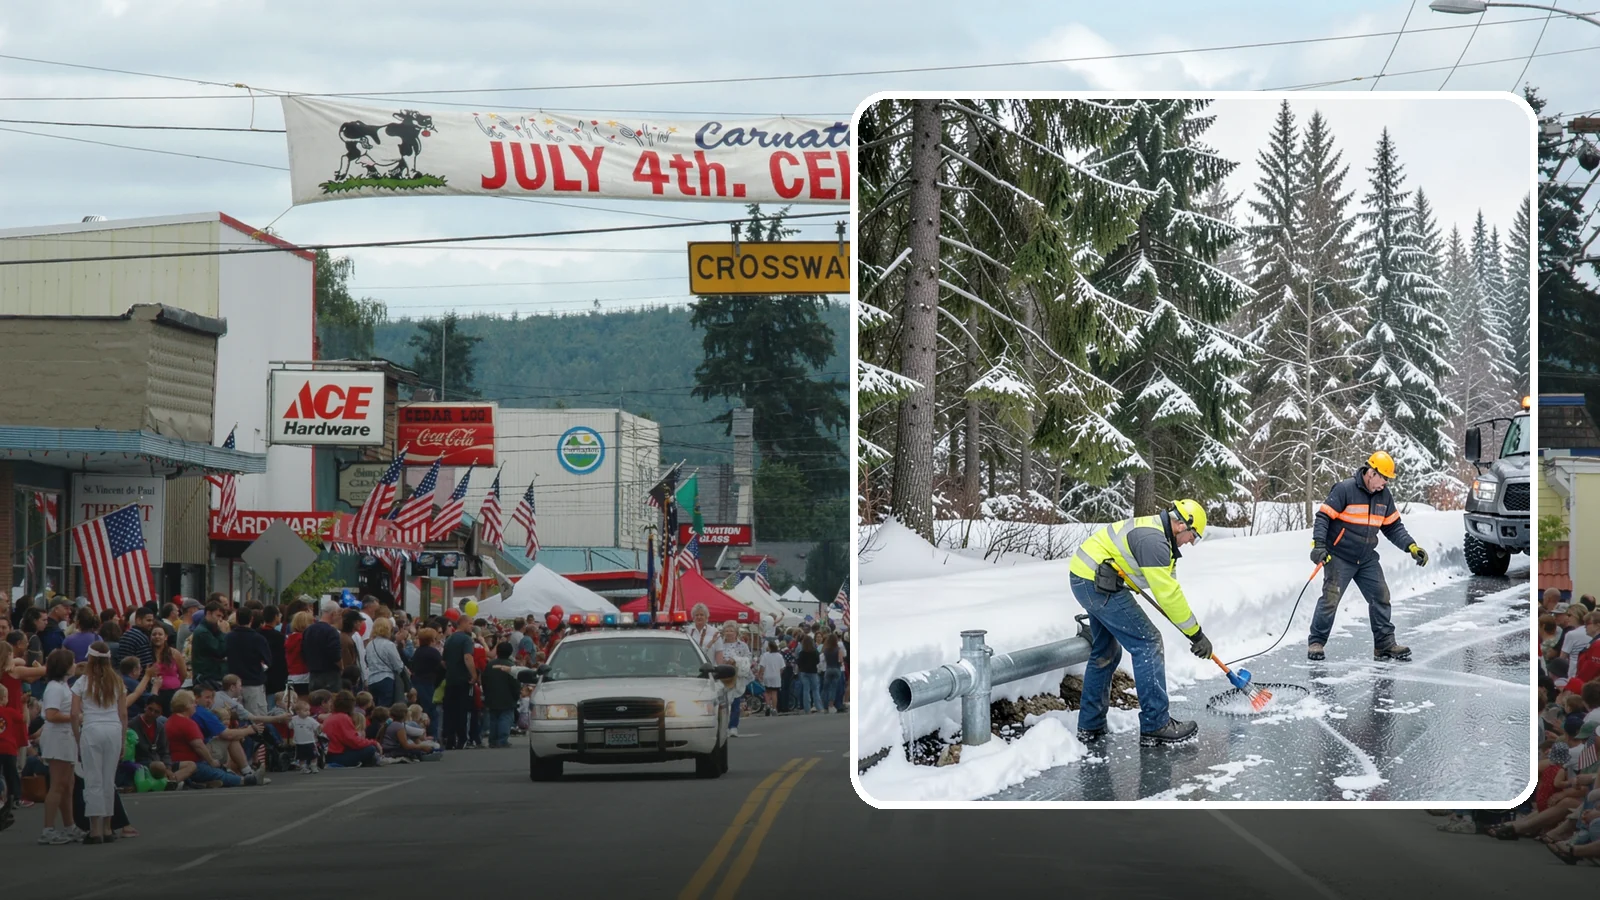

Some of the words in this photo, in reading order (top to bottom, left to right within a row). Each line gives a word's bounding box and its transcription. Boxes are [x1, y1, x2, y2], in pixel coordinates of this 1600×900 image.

[481, 141, 605, 192] JULY
[632, 150, 746, 197] 4th.
[697, 254, 850, 280] CROSSWA
[283, 380, 373, 420] ACE
[405, 409, 452, 422] CEDAR
[283, 421, 371, 436] Hardware
[416, 428, 477, 447] Coca-Cola
[95, 485, 124, 494] Vincent
[126, 486, 136, 494] de
[138, 486, 155, 495] Paul
[212, 515, 331, 535] HARDARE
[688, 526, 741, 535] CRNATION
[699, 535, 730, 543] GLASS
